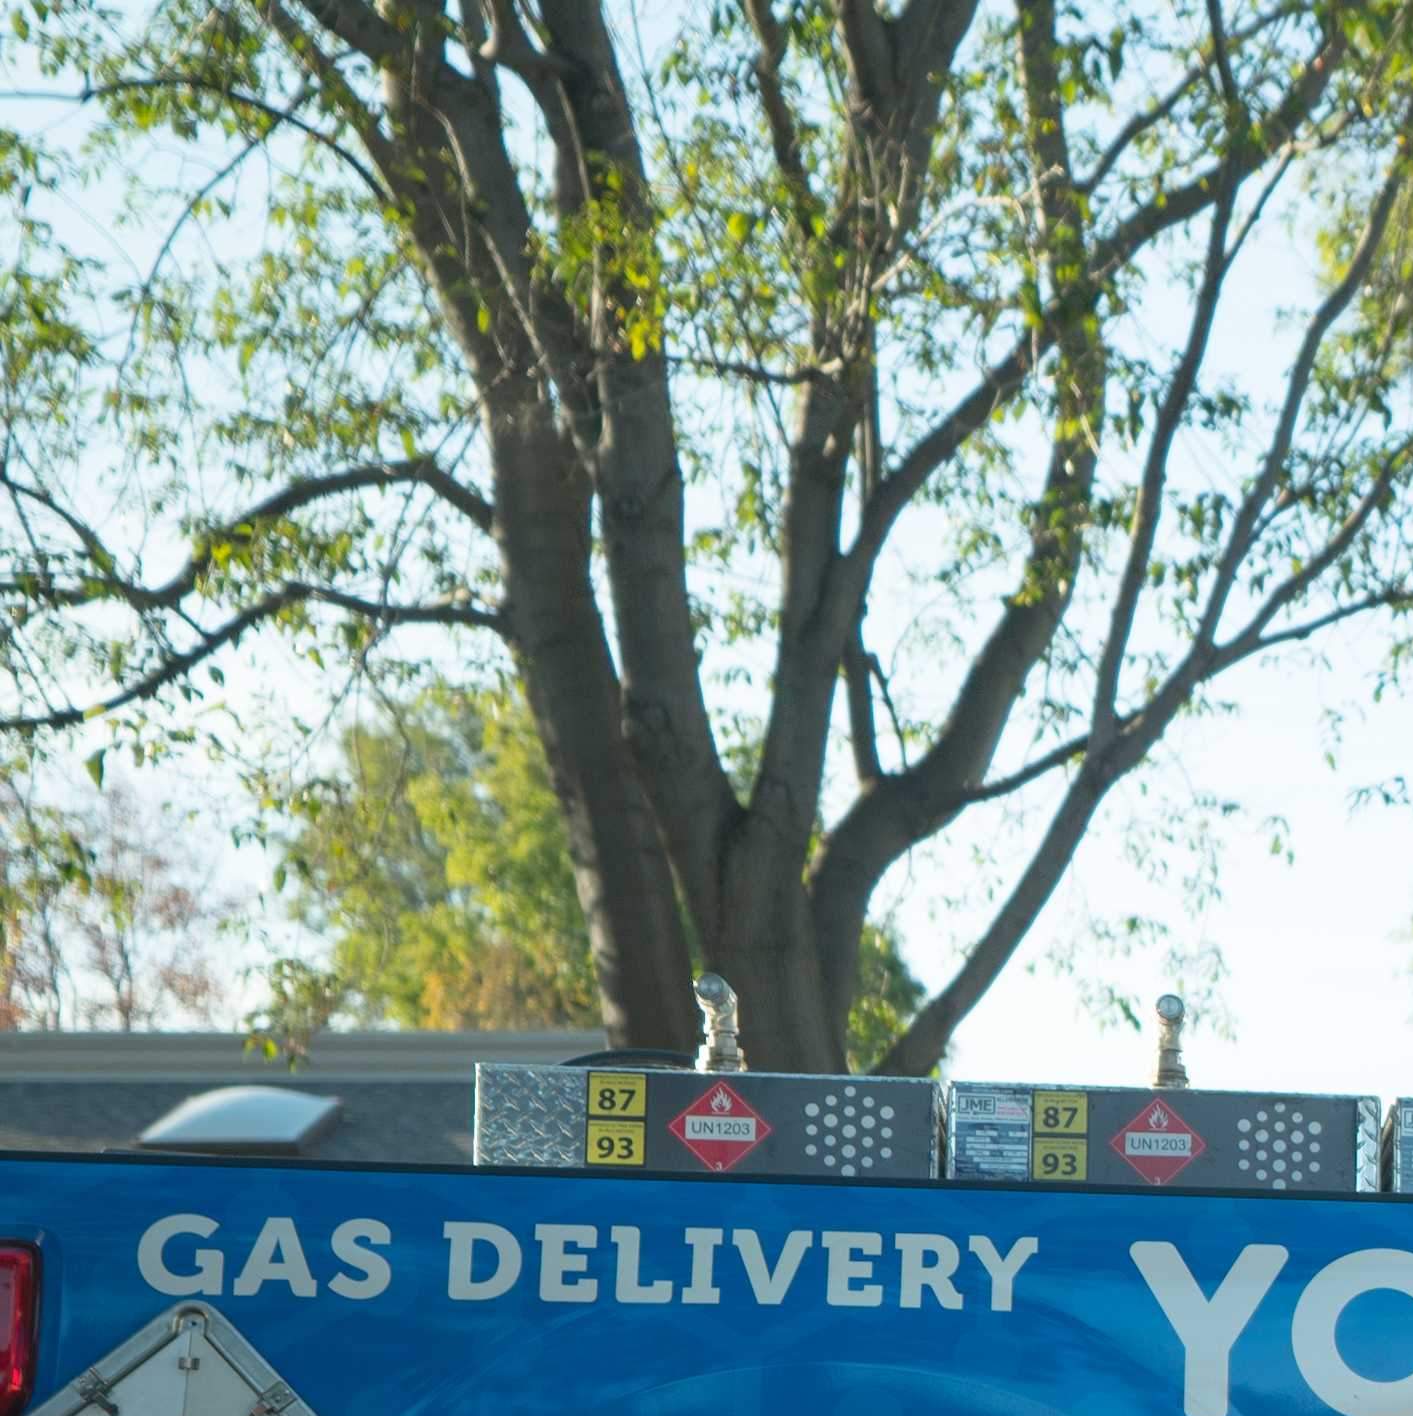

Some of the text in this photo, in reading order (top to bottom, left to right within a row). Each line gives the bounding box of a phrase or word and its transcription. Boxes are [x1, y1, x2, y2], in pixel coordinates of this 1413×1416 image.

[598, 1088, 636, 1111] 87
[960, 1098, 992, 1111] JME
[691, 1120, 750, 1136] UN1203
[1042, 1106, 1078, 1129] 87
[596, 1136, 634, 1160] 93
[1130, 1137, 1186, 1151] UN1203
[1042, 1153, 1078, 1175] 93
[137, 1213, 1039, 1311] GAS DELIVERY
